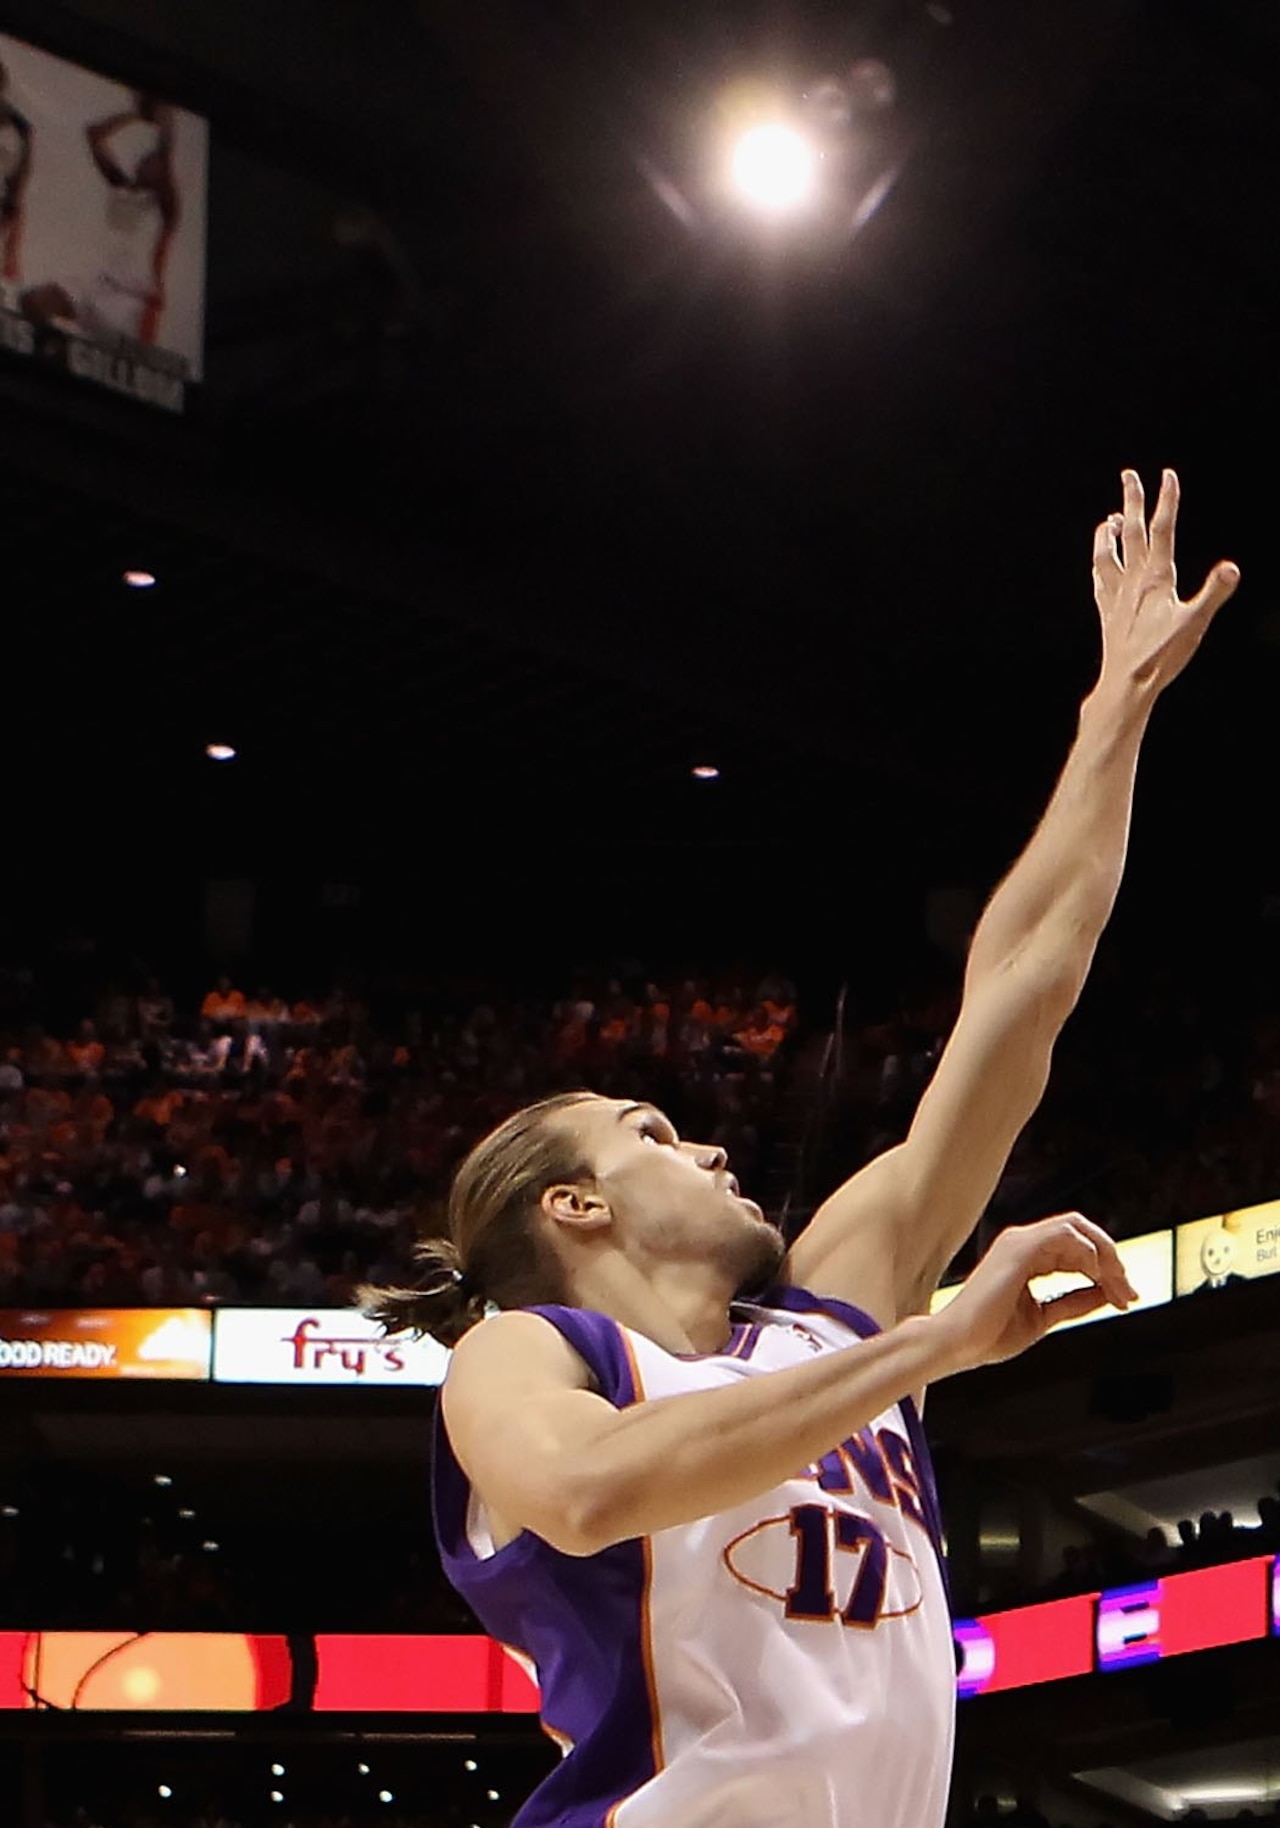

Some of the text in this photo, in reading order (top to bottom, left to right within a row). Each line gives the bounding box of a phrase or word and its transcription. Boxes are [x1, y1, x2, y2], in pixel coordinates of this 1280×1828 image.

[1256, 1245, 1278, 1262] But
[281, 1318, 405, 1376] fry's
[785, 1503, 889, 1629] 17
